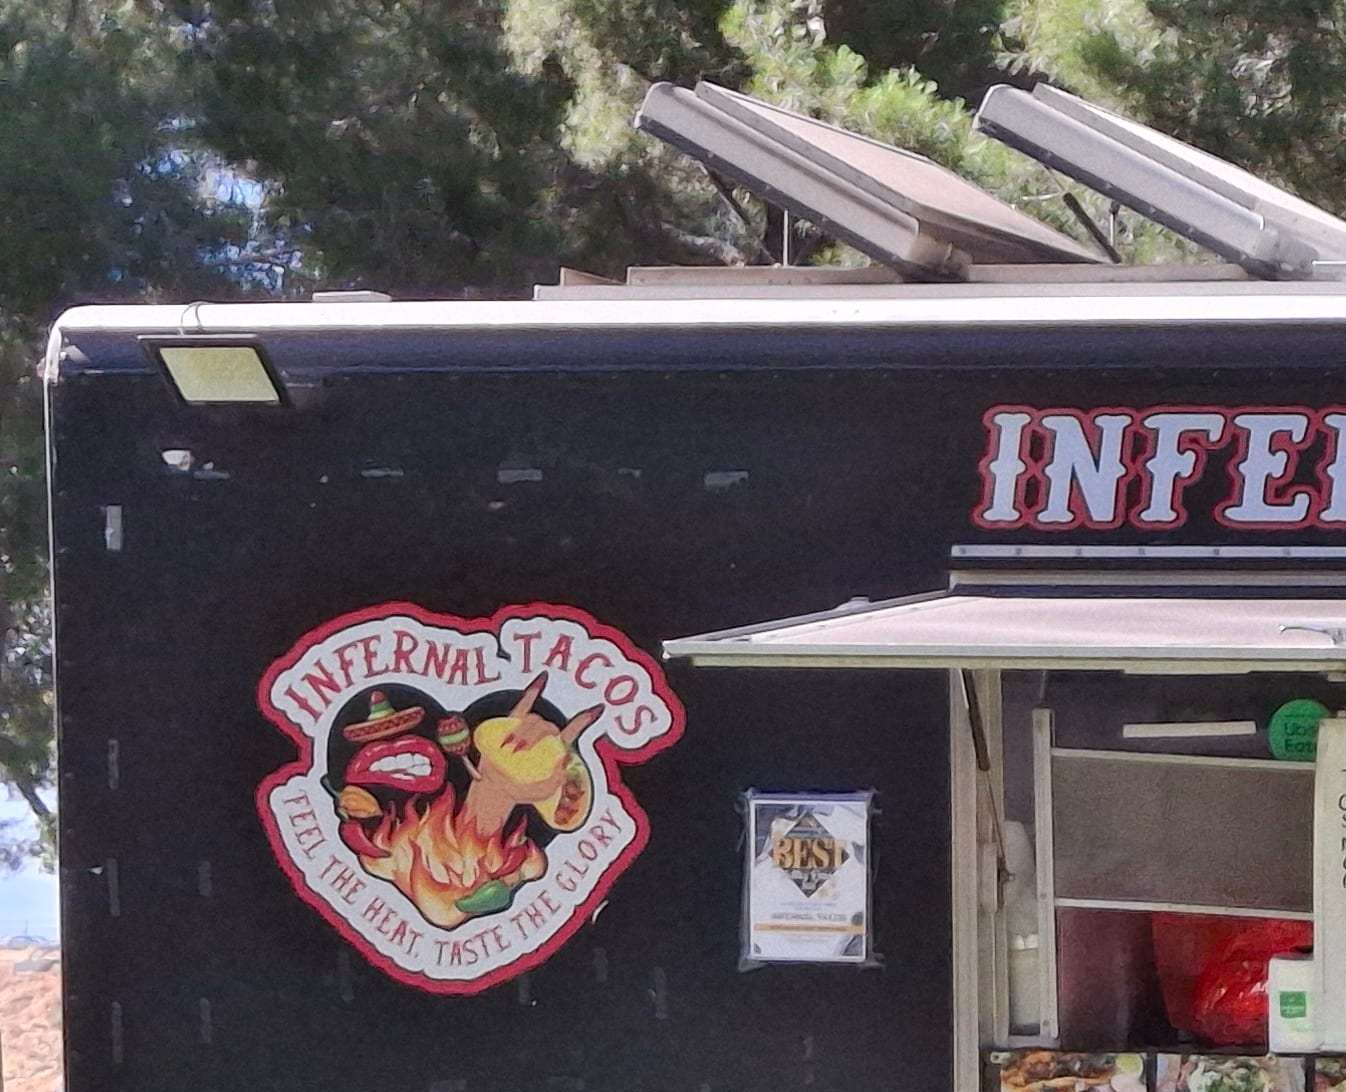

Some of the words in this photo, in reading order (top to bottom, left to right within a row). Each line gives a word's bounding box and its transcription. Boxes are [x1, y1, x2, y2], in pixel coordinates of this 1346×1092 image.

[284, 630, 501, 723] INFERNAL
[513, 630, 658, 736] TACOS
[284, 789, 328, 861] FEEL
[320, 855, 366, 905] THE
[434, 925, 511, 965] TASTE
[509, 890, 561, 940] THE
[555, 808, 621, 892] GLORY
[773, 837, 847, 870] BEST
